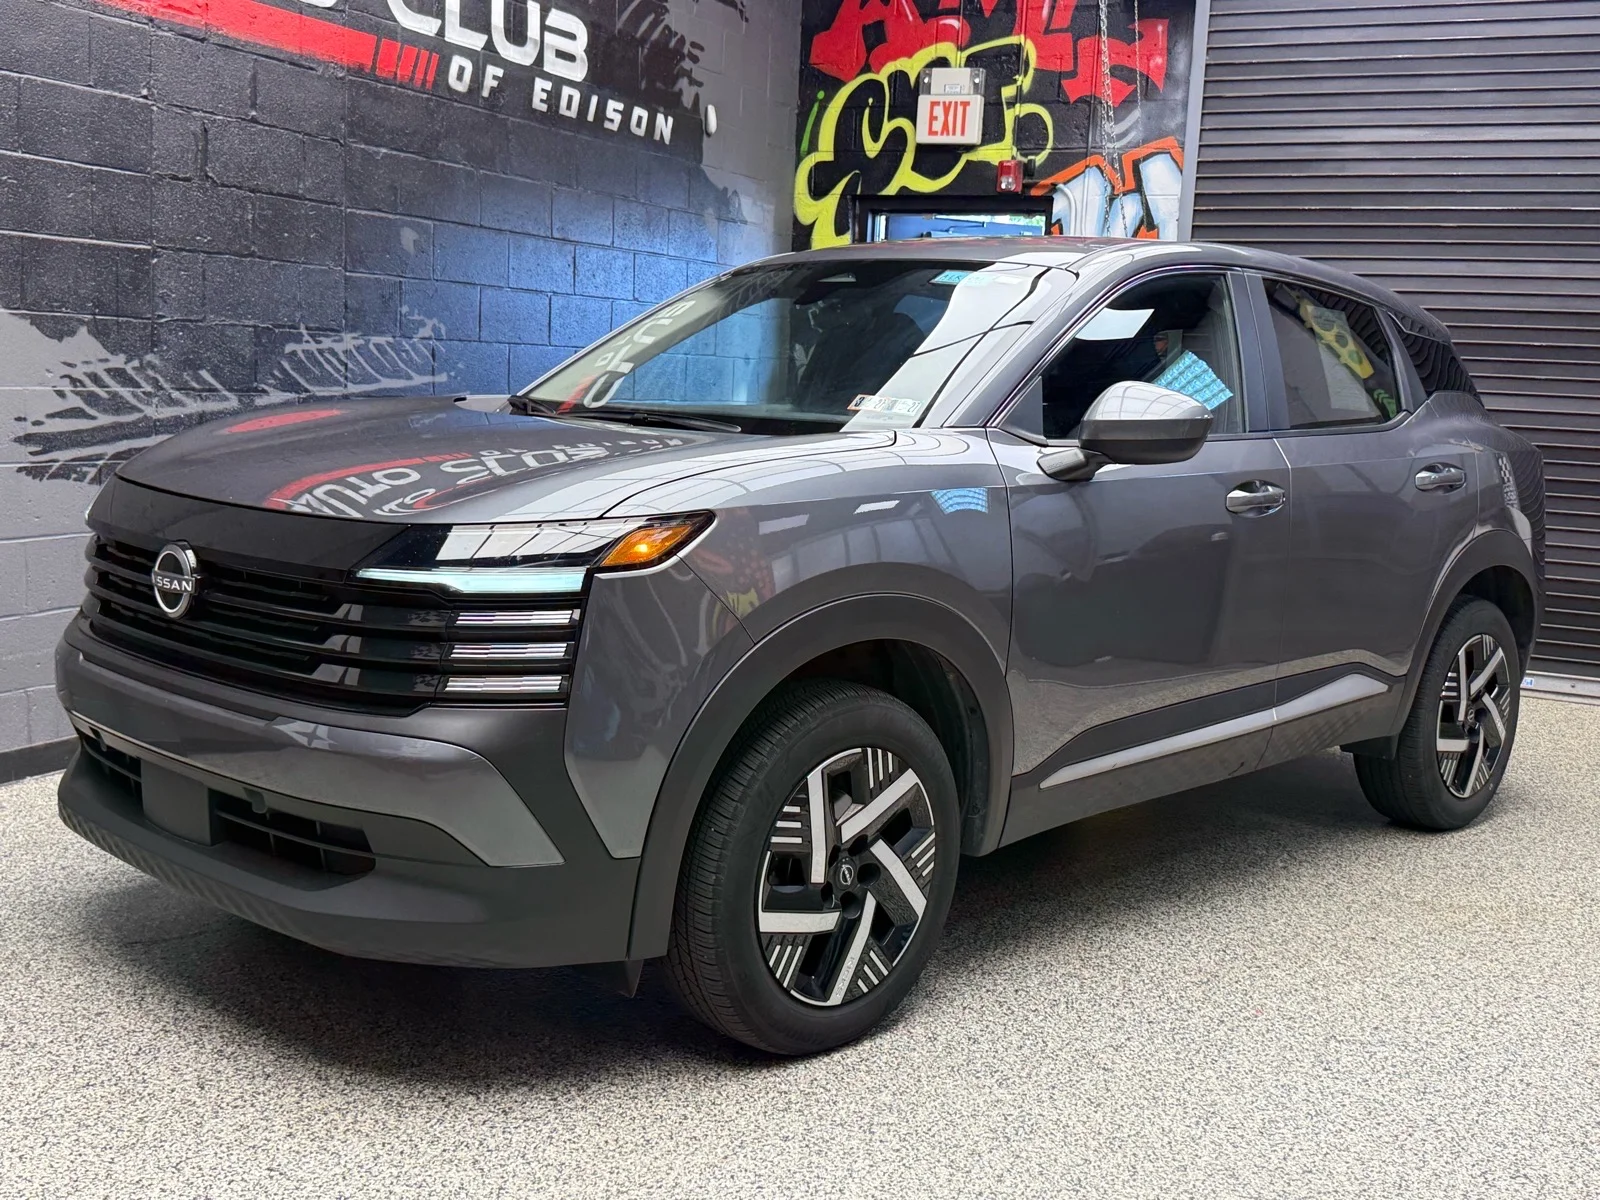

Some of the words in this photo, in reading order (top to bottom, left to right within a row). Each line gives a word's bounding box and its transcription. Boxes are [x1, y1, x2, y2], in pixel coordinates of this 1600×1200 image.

[448, 54, 504, 98] OF
[532, 77, 674, 145] EDISON
[928, 101, 970, 136] EXIT
